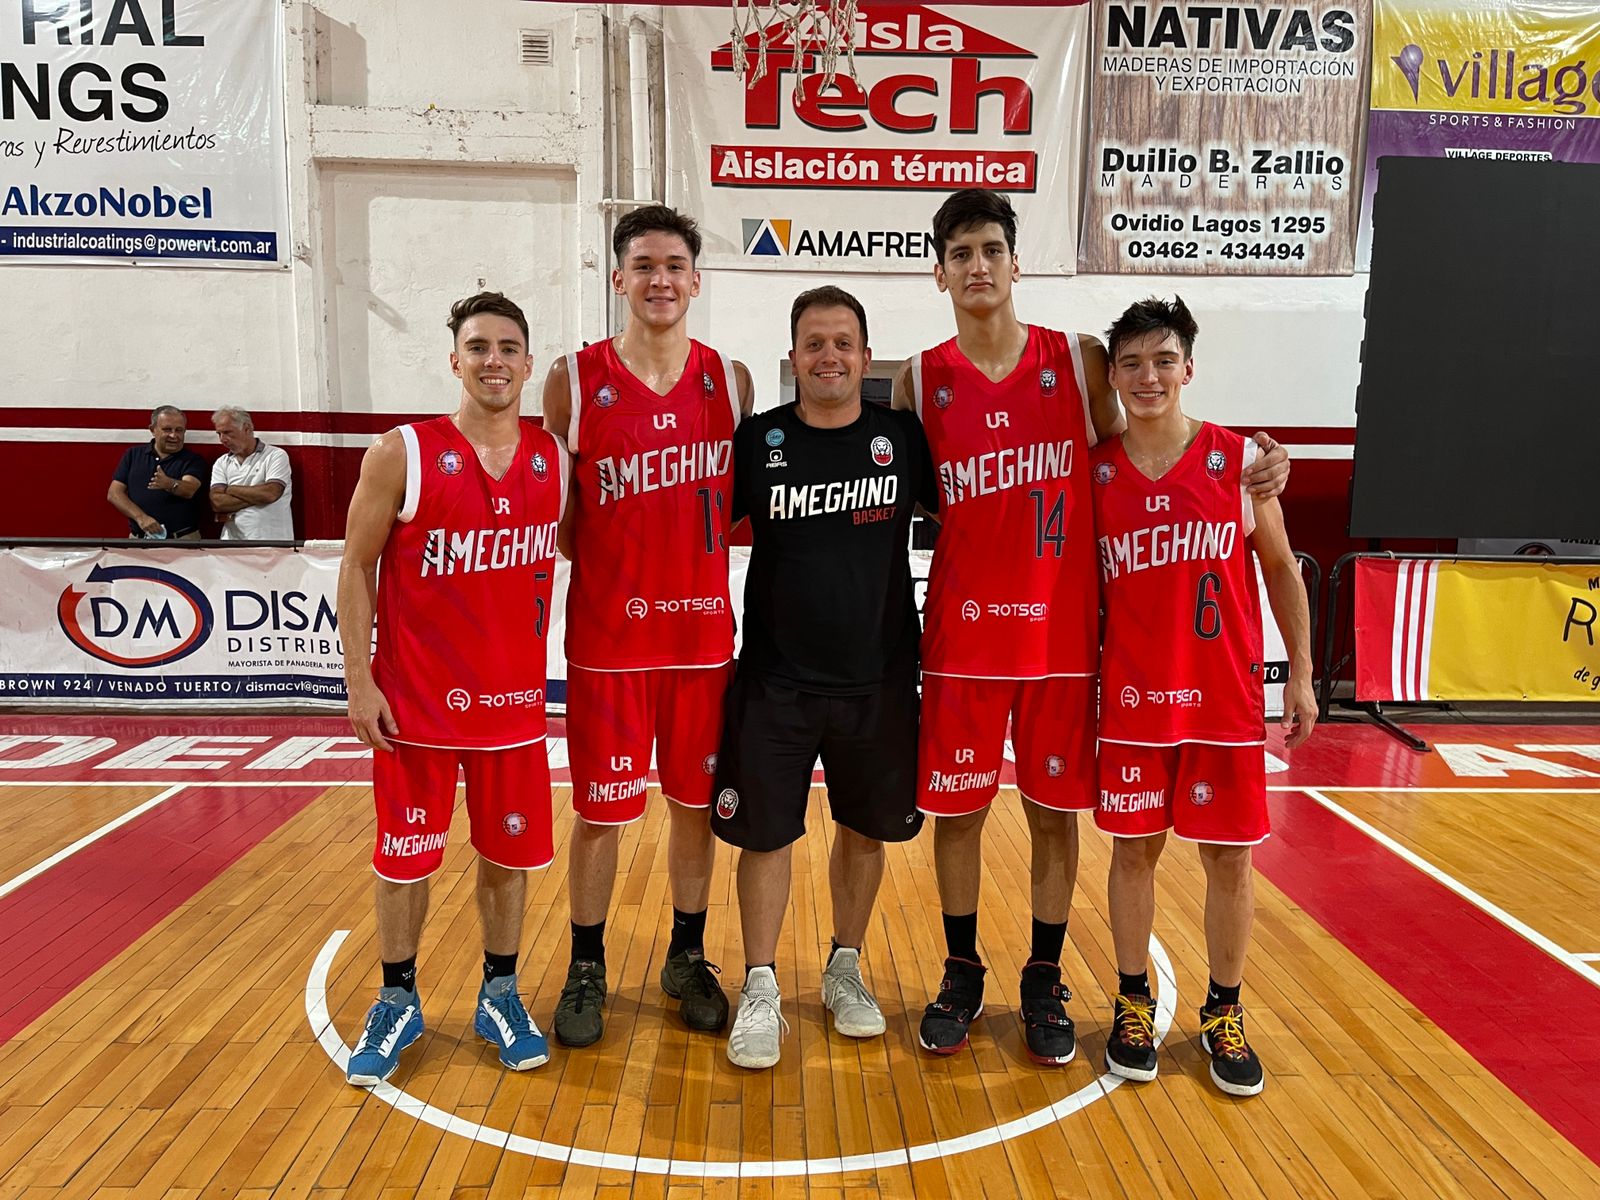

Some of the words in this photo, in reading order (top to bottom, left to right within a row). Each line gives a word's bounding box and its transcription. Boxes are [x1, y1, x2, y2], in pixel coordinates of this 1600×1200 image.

[22, 0, 205, 47] RIAL
[782, 5, 966, 52] Aisla
[1107, 5, 1356, 53] NATIVAS
[1103, 56, 1192, 73] MADERAS
[1198, 58, 1223, 74] DE
[1228, 57, 1355, 77] IMPORTACIÓN
[0, 62, 170, 123] NGS
[711, 50, 1033, 135] Tech
[1155, 76, 1166, 91] Y
[1172, 74, 1301, 93] EXPORTACIÓN
[1429, 114, 1490, 127] SPORTS
[1494, 117, 1503, 127] &
[1508, 119, 1576, 130] FASHION
[34, 140, 46, 169] y
[53, 126, 217, 155] Revestimientos
[1447, 150, 1493, 160] VILLAGE
[1495, 152, 1551, 162] DEPORTES
[718, 150, 879, 183] Aislación
[891, 153, 1027, 184] térmica
[1102, 147, 1197, 173] Duilio
[1209, 149, 1240, 174] B.
[1251, 149, 1345, 175] Zallio
[2, 184, 213, 219] AkzoNobel
[1111, 213, 1184, 232] Ovidio
[1192, 214, 1262, 236] Lagos
[1270, 216, 1326, 234] 1295
[13, 231, 272, 255] industrialcoatings@powervt.com.ar
[1128, 241, 1198, 259] 03462
[1220, 243, 1305, 260] 434494
[652, 413, 677, 430] UR
[985, 411, 1010, 429] UR
[594, 439, 733, 506] AMEGHINO
[937, 439, 1074, 507] AMEGHINO
[769, 475, 898, 520] AMEGHINO
[1145, 495, 1171, 512] UR
[853, 506, 897, 526] BASKET
[1029, 489, 1066, 559] 14
[420, 520, 558, 578] AMEGHINO
[1098, 520, 1237, 584] AMEGHINO
[225, 590, 340, 633] DISM
[1193, 571, 1223, 641] 6
[90, 597, 182, 640] DM
[1563, 596, 1598, 646] R
[227, 637, 346, 656] DISTRIBU
[228, 660, 271, 668] MAYORISTA
[326, 662, 344, 671] REPO
[1263, 666, 1279, 680] TO
[1574, 666, 1590, 682] de
[0, 679, 55, 691] BROWN
[63, 680, 91, 691] 924
[97, 680, 103, 692] /
[108, 681, 167, 693] VENADO
[175, 681, 231, 693] TUERTO
[235, 681, 242, 693] /
[611, 756, 633, 772] UR
[955, 748, 975, 764] UR
[928, 769, 997, 792] AMEGHINO
[1122, 766, 1141, 783] UR
[587, 775, 647, 803] AMEGHIN
[406, 806, 427, 825] UR
